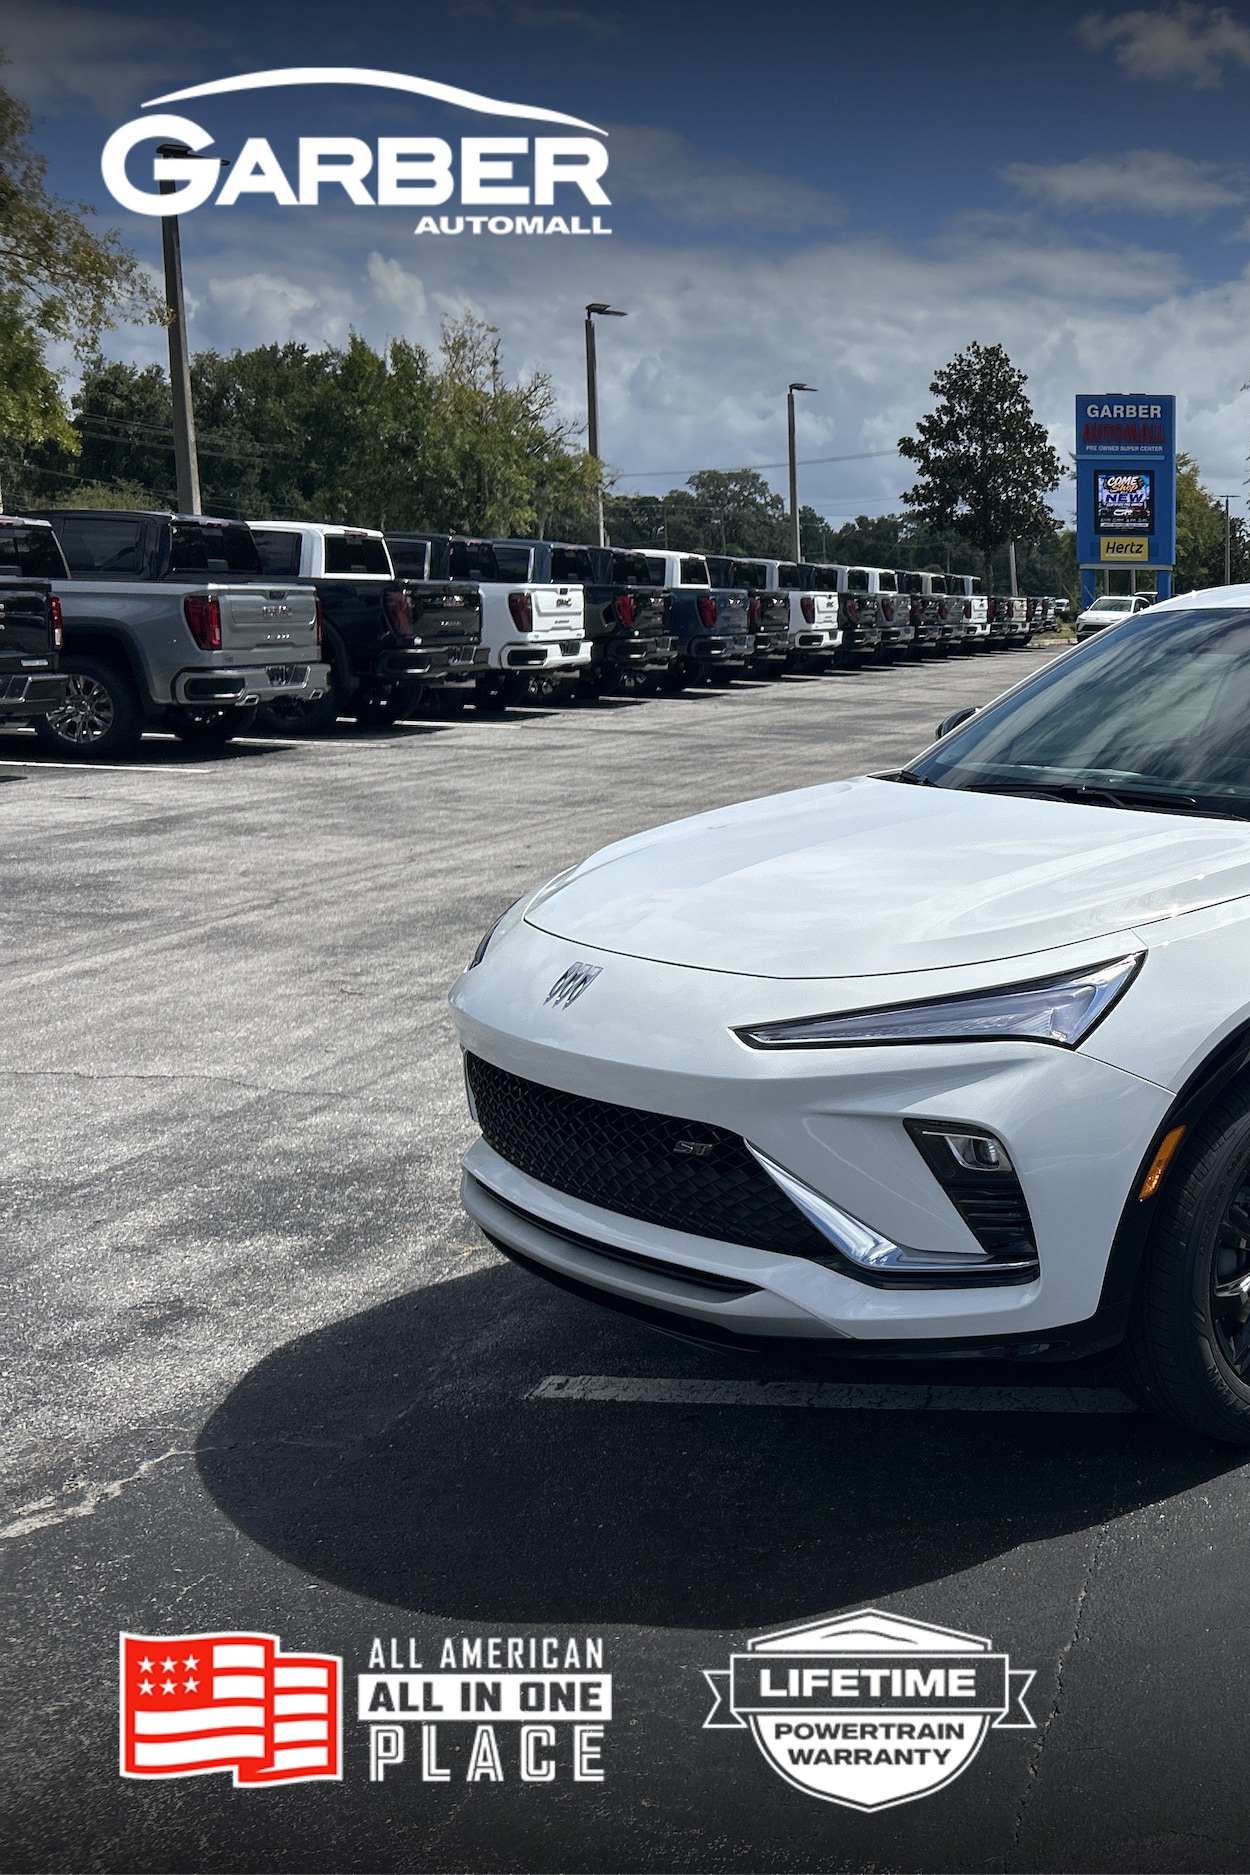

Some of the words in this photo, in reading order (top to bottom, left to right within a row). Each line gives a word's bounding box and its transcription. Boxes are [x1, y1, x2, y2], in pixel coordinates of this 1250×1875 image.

[1086, 404, 1162, 418] GARBER
[1083, 423, 1165, 442] AUTOMALL
[1107, 476, 1139, 486] COME
[1105, 493, 1144, 501] NEW
[1105, 541, 1144, 553] Hertz
